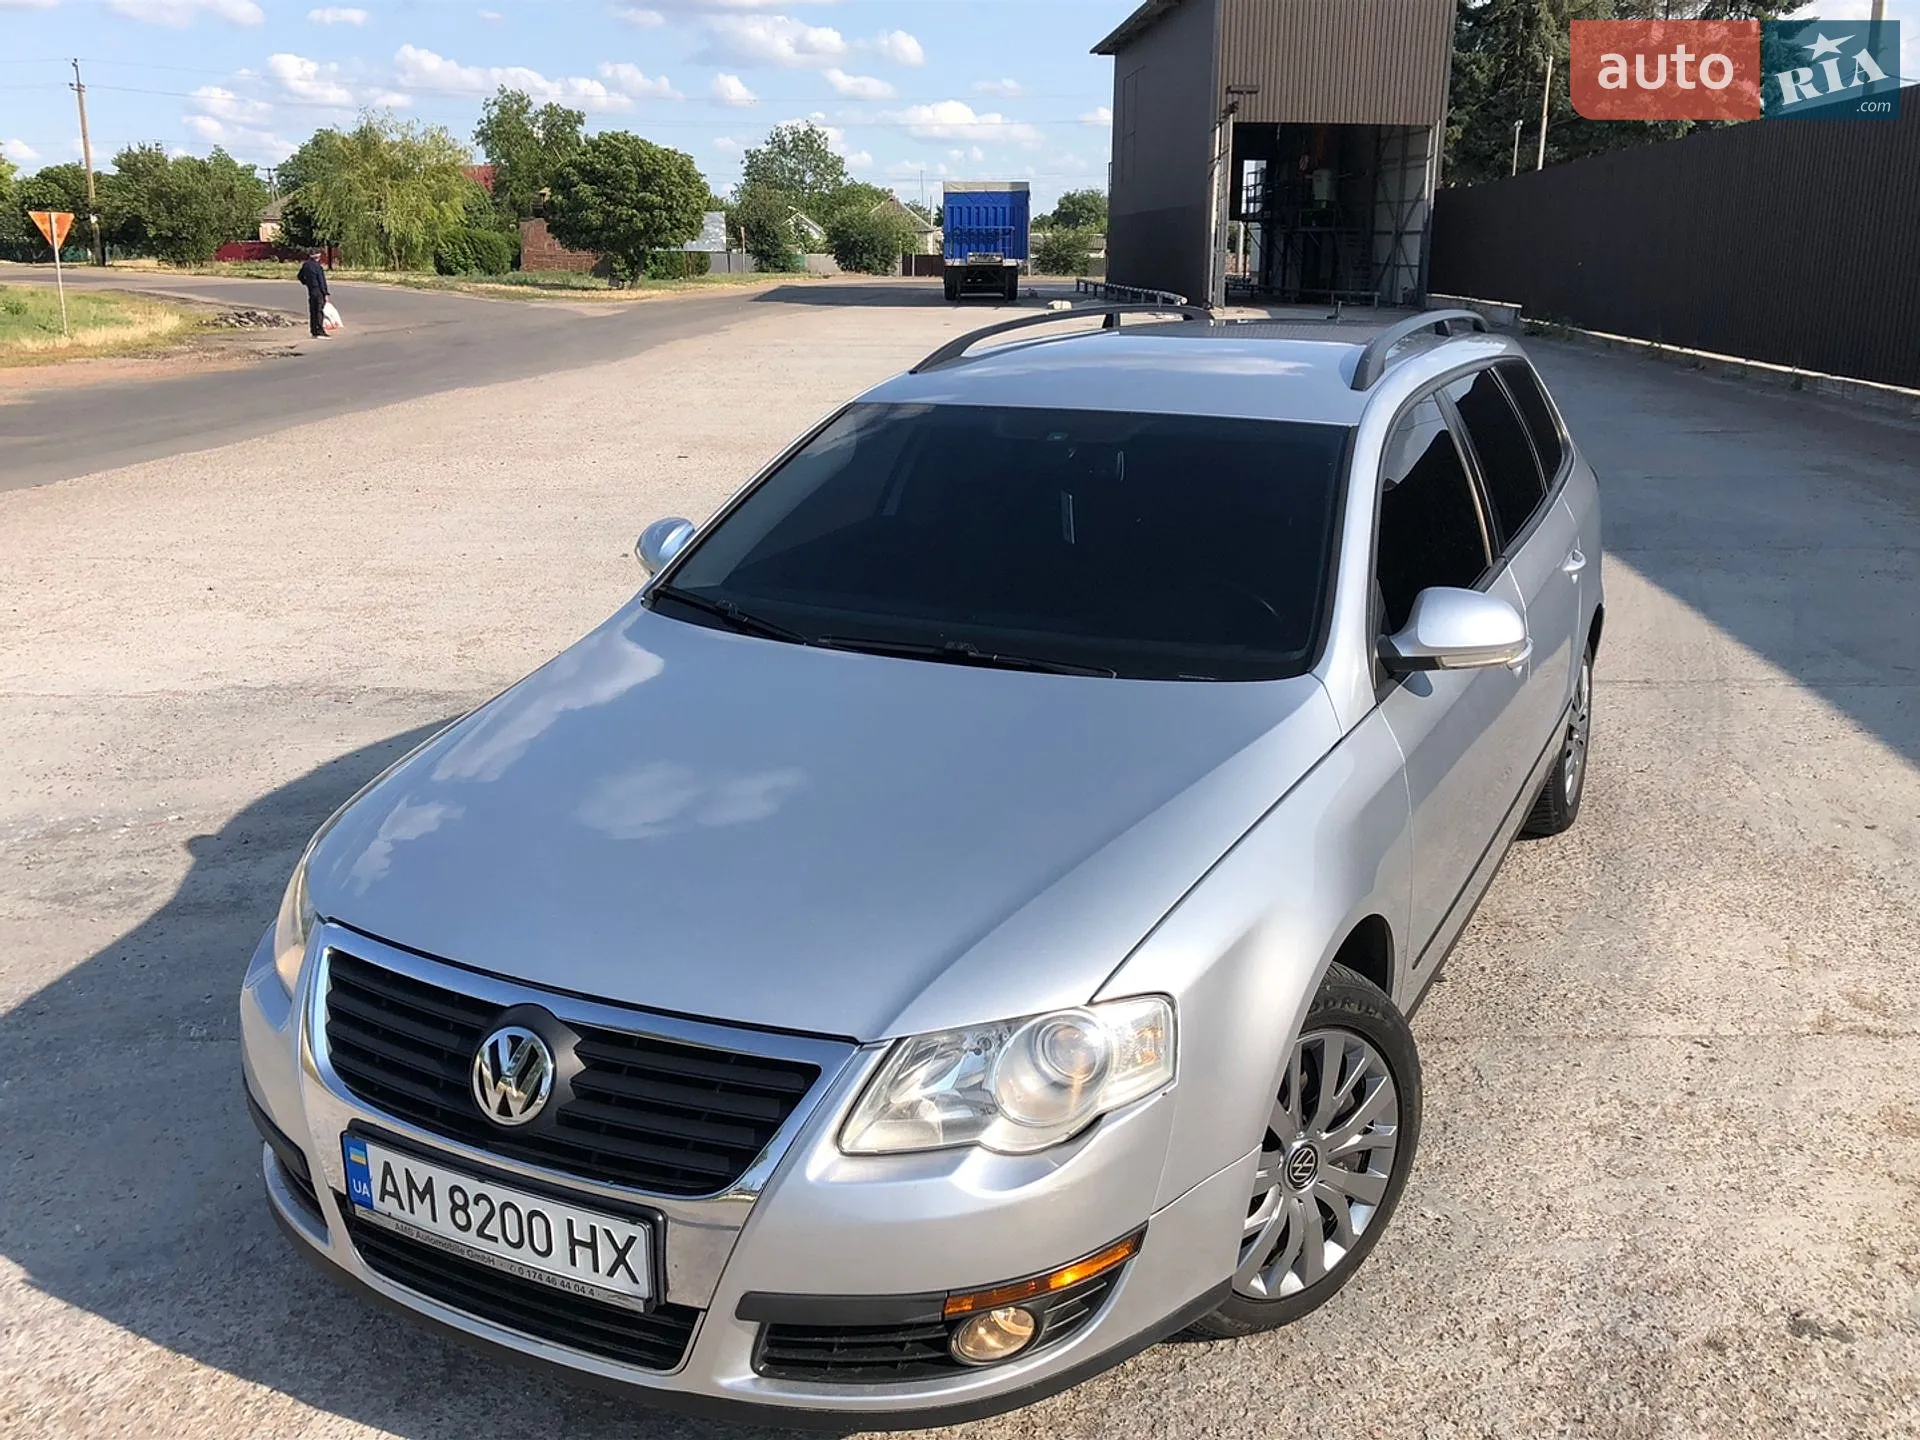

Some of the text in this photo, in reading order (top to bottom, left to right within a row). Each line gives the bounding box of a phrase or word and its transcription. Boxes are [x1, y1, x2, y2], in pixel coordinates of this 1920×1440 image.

[352, 1179, 370, 1196] UA
[379, 1159, 639, 1285] AM 8200 HX
